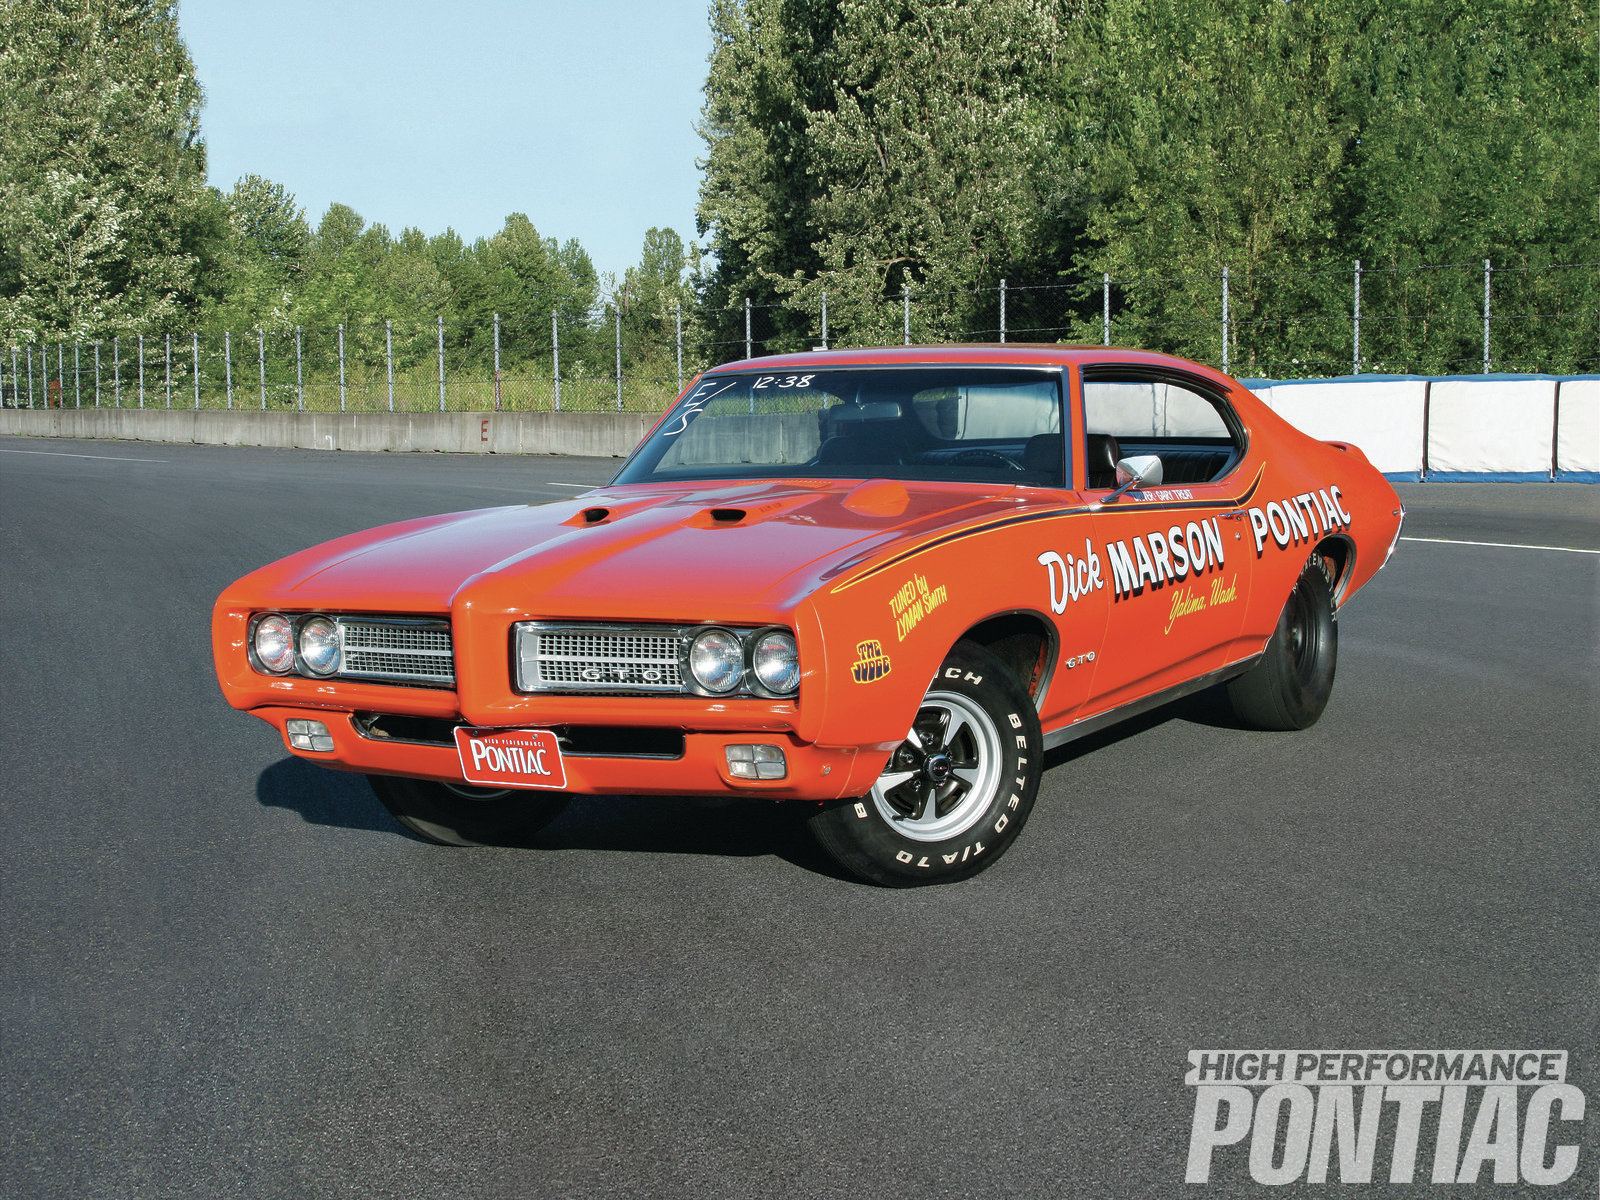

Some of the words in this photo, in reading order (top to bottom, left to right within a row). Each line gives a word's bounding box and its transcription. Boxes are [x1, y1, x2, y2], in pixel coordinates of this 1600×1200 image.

[752, 374, 816, 389] 12:38
[481, 420, 489, 441] E
[1171, 488, 1194, 500] TREAT
[1037, 538, 1104, 615] Dick
[1105, 516, 1224, 600] MARSON
[1248, 484, 1352, 557] PONTIAC
[888, 580, 917, 619] TUNED
[914, 573, 930, 597] by
[1209, 572, 1237, 607] Wash.
[896, 598, 925, 642] LYMAN
[922, 584, 948, 614] SMITH
[857, 640, 883, 661] THE
[1065, 651, 1096, 669] GTO
[581, 669, 662, 681] GTO
[851, 655, 892, 684] JUDGE
[469, 738, 552, 776] PONTIAC
[994, 712, 1028, 834] BELTED
[895, 849, 930, 868] 70
[941, 841, 986, 865] T/A
